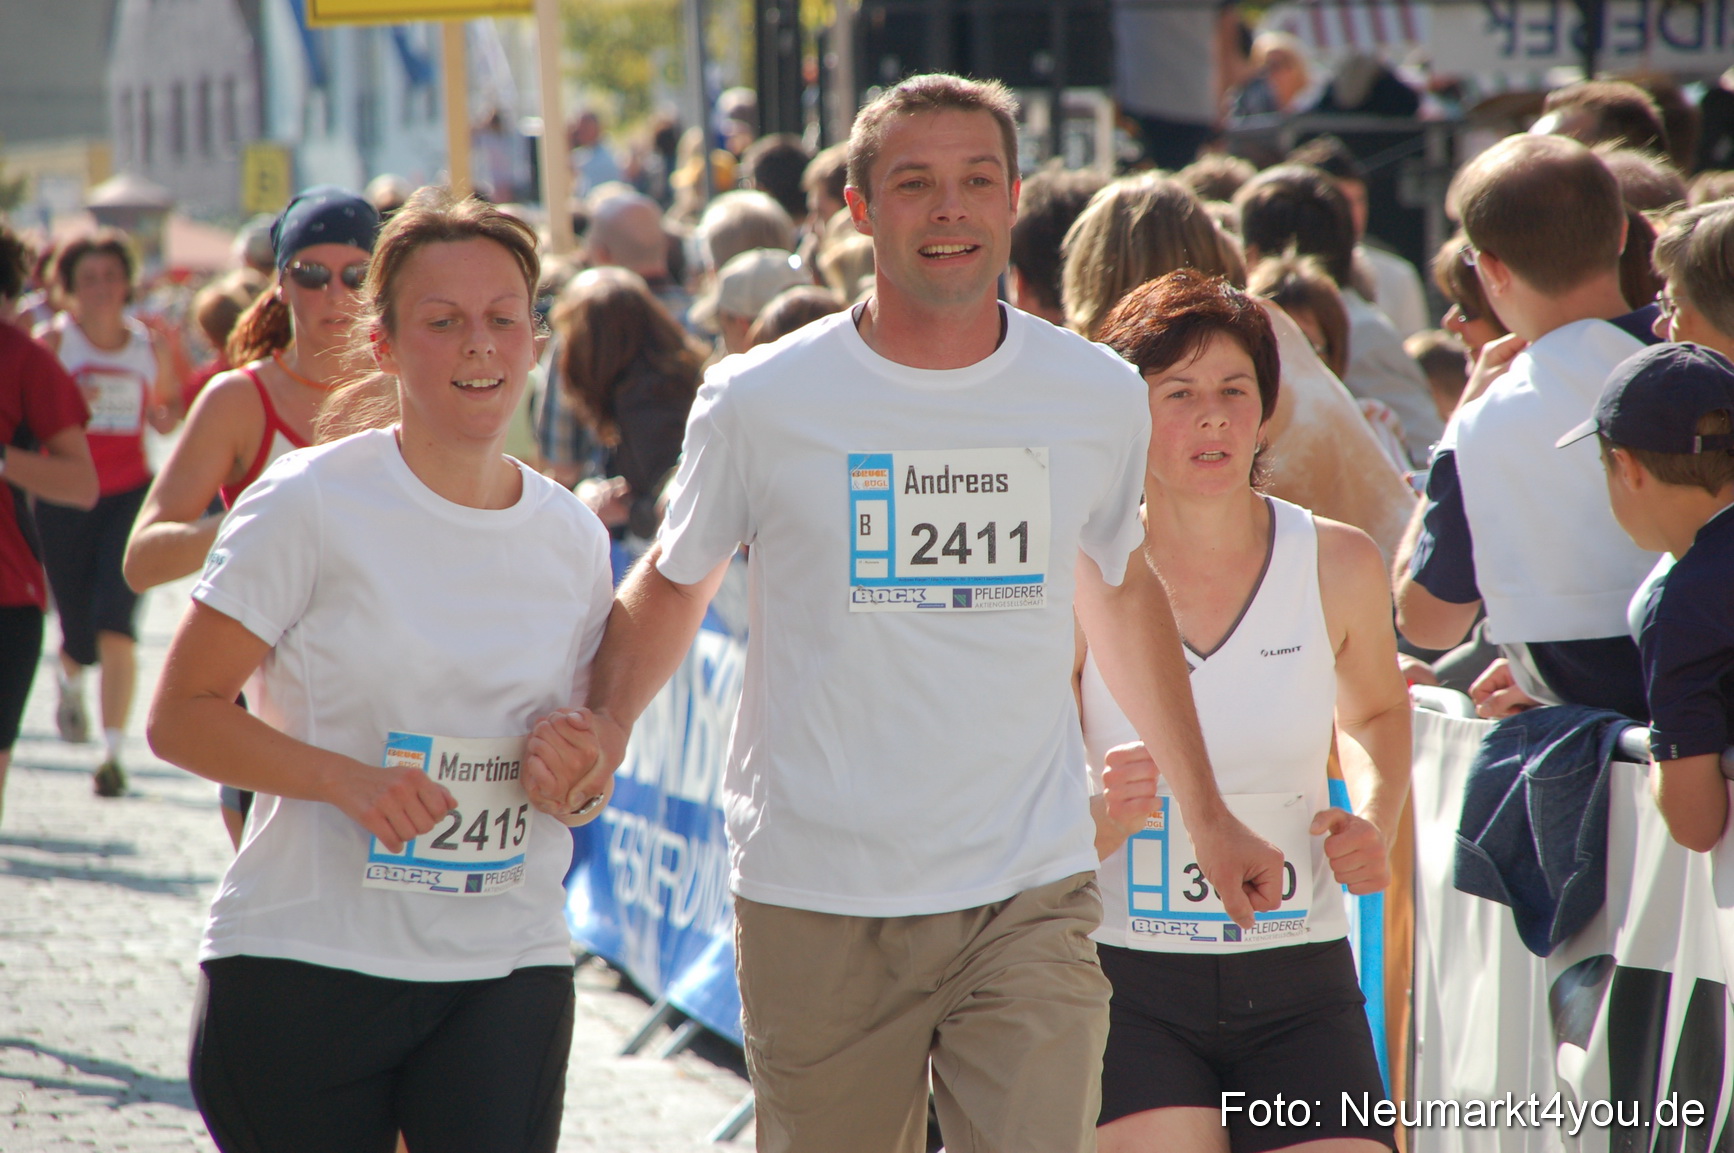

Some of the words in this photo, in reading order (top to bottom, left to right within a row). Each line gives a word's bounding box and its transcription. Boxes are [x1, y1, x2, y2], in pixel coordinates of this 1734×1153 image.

[904, 464, 1009, 494] Andreas
[859, 514, 871, 536] B
[910, 520, 1028, 565] 2411
[852, 588, 927, 604] BOCK
[975, 585, 1044, 600] PFLEIDERER
[975, 600, 1044, 609] AKTIENGESELLSCHAFT
[437, 752, 521, 782] Martina
[430, 803, 528, 851] 2415
[366, 865, 443, 886] BOCK
[1182, 860, 1297, 903] 30
[1132, 919, 1199, 936] BOCK
